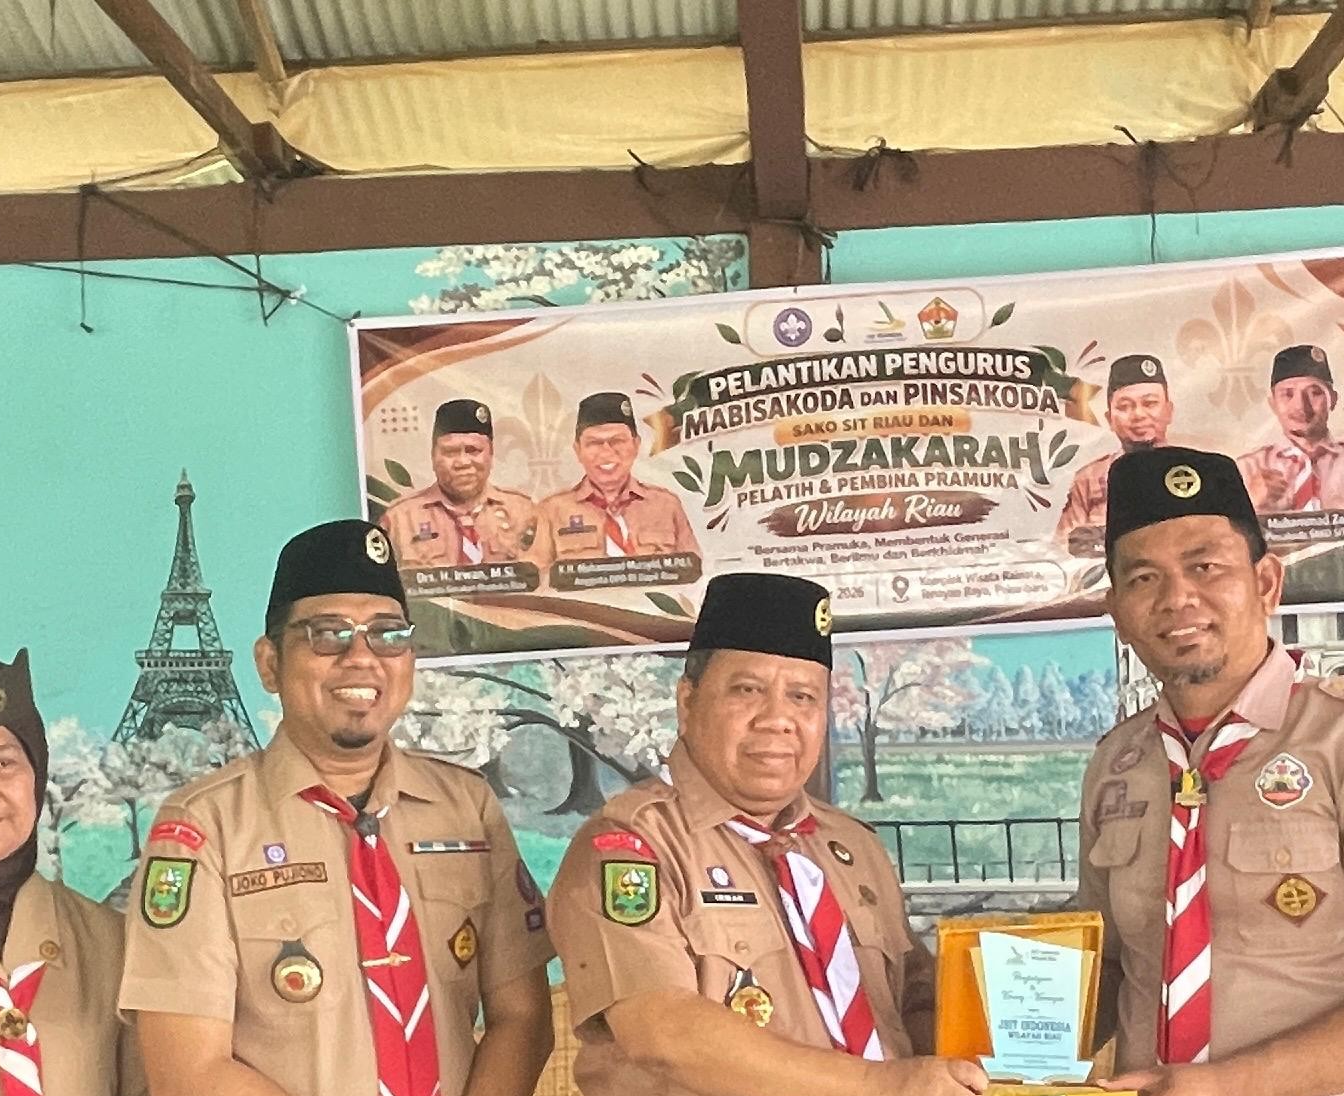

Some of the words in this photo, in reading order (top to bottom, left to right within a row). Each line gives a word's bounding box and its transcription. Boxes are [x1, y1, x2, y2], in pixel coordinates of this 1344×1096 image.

[708, 354, 878, 401] PELANTIKAN
[884, 352, 1033, 380] PENGURUS
[684, 387, 855, 440] MABISAKODA
[860, 390, 898, 407] DAN
[903, 382, 1060, 414] PINSAKODA
[792, 421, 837, 437] SAKO
[843, 418, 868, 432] SIT
[873, 414, 913, 430] RIAU
[918, 414, 954, 428] DAN
[704, 431, 1051, 507] MUDZAKARAH
[737, 480, 814, 508] PELATIH
[819, 479, 832, 494] &
[838, 473, 919, 492] PEMBINA
[924, 472, 1019, 489] PRAMUKA
[794, 498, 897, 533] Wilayah
[904, 494, 963, 523] Riau
[236, 872, 268, 893] JOKO
